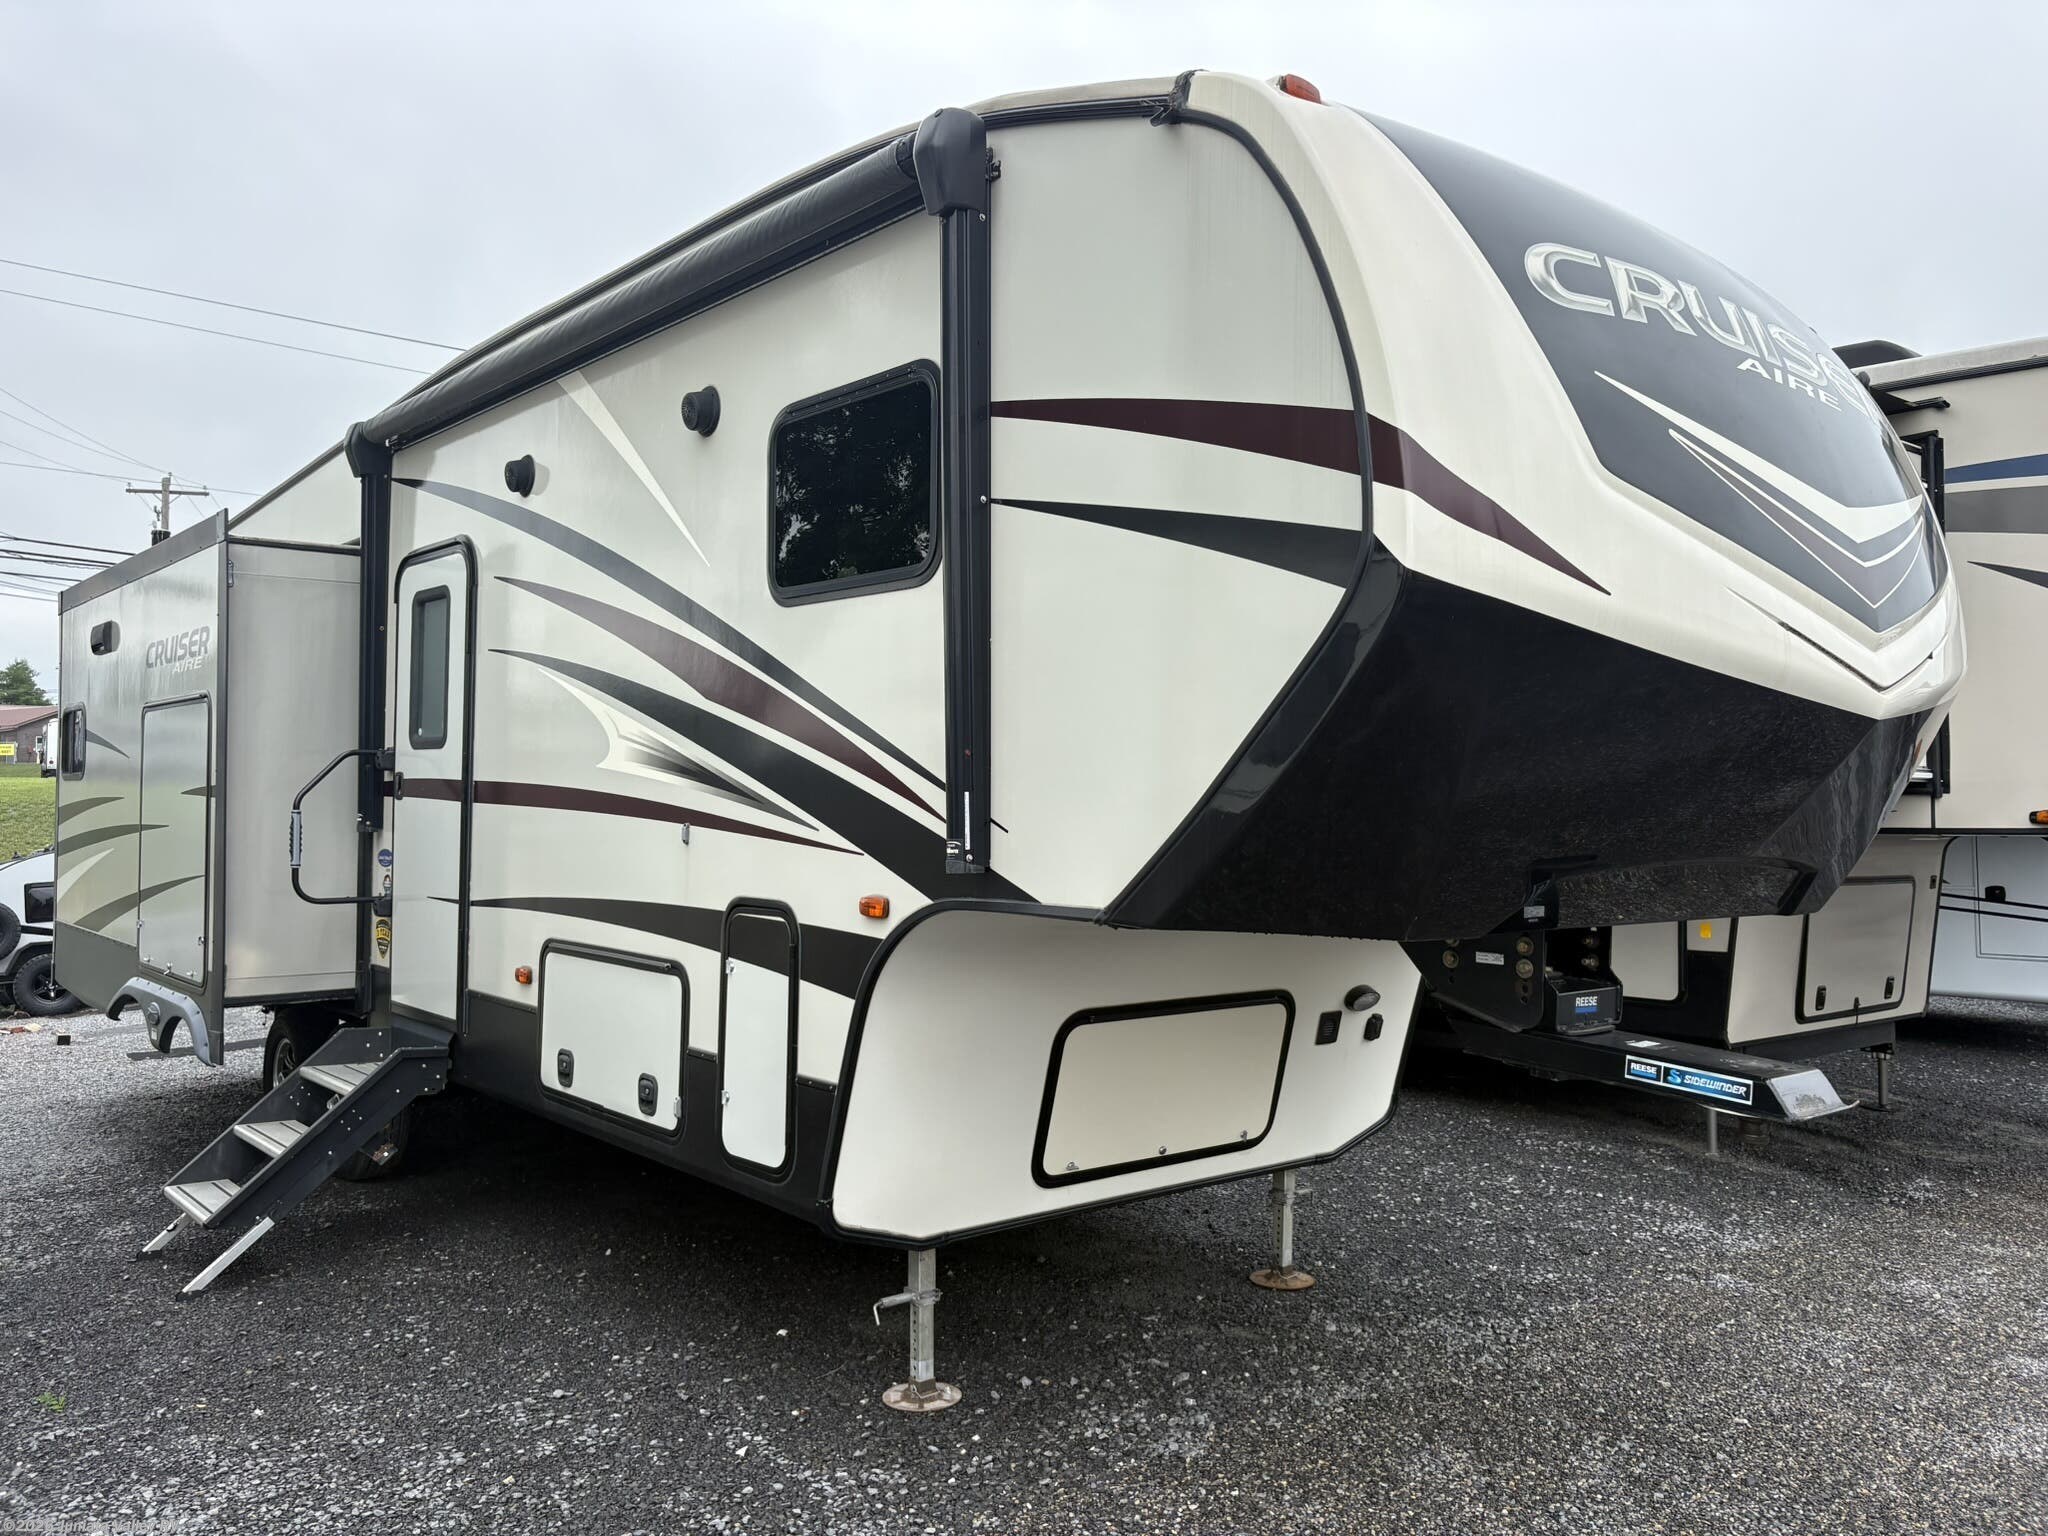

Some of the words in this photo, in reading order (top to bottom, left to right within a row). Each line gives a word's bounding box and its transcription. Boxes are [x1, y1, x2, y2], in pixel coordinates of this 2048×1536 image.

[1736, 358, 1842, 412] AIRE
[145, 626, 210, 669] CRUISER
[171, 655, 202, 674] AIRE
[1575, 995, 1598, 1007] REESE
[1630, 1062, 1657, 1075] REESE
[1683, 1074, 1747, 1097] SIDEWINDER
